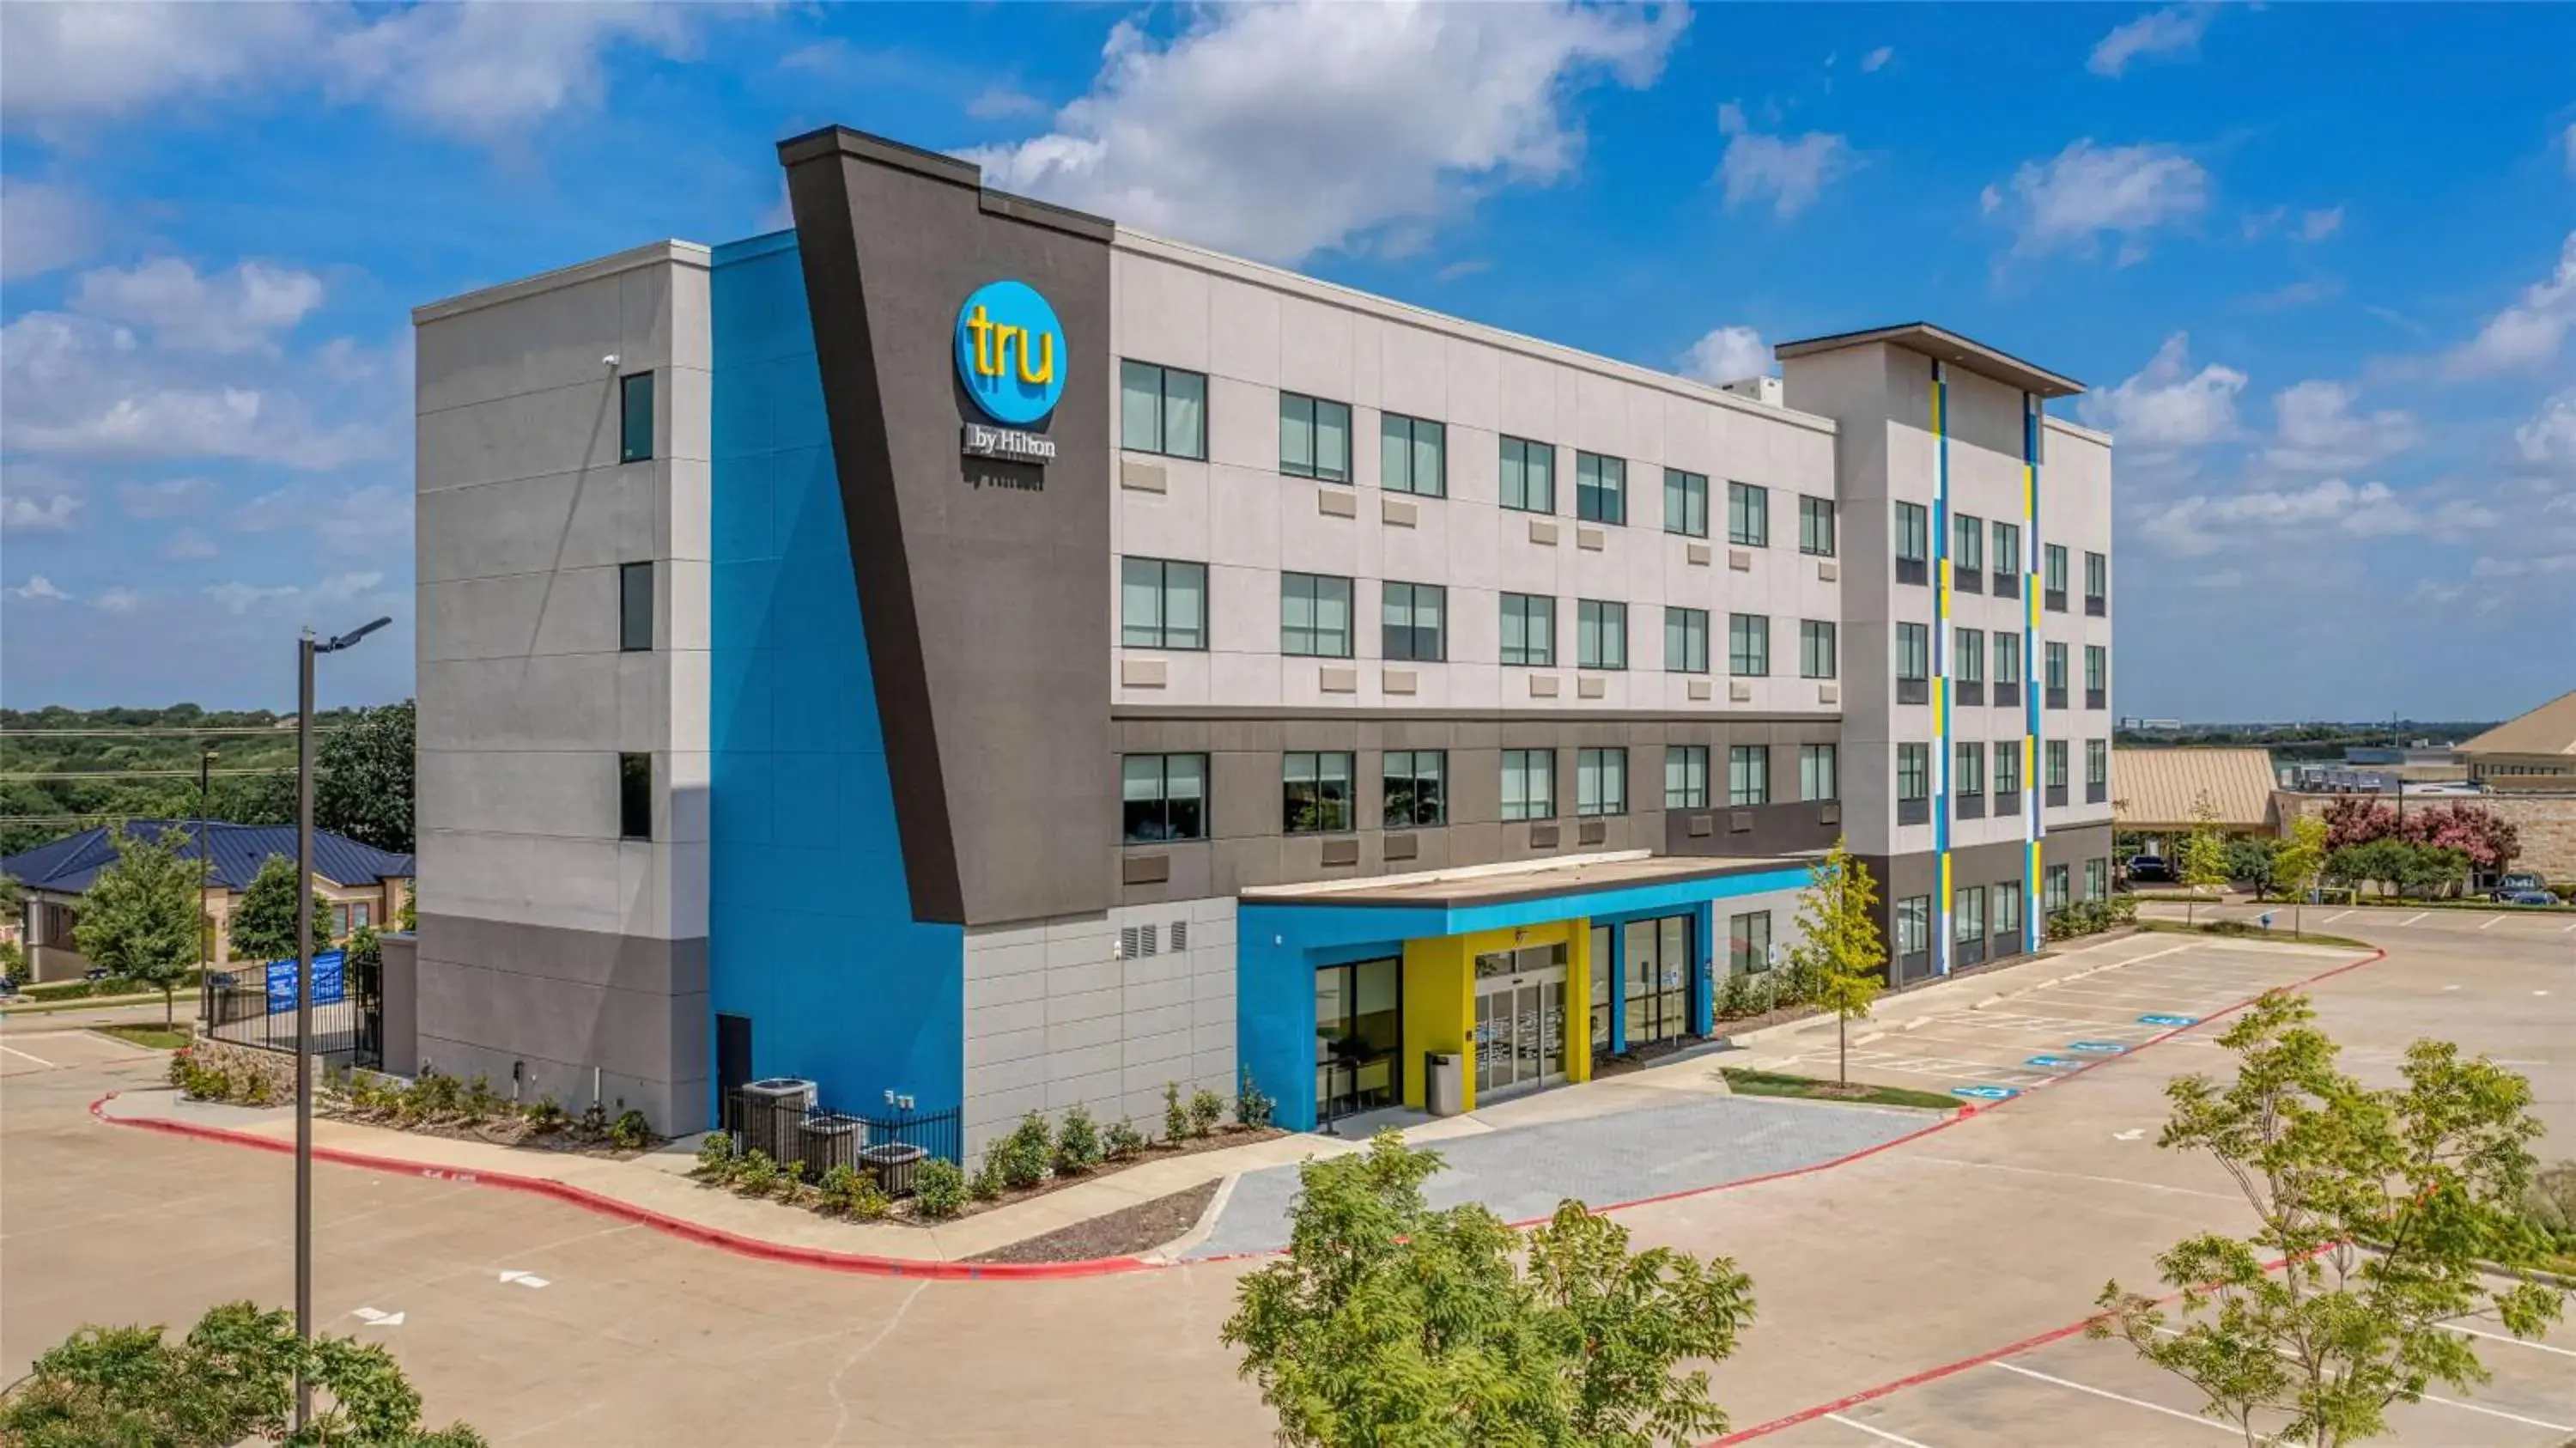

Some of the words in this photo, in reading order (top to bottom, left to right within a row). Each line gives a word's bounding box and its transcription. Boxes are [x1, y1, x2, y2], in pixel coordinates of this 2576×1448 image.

[967, 305, 1053, 384] tru
[975, 427, 996, 453] by
[1000, 430, 1055, 457] Hilton
